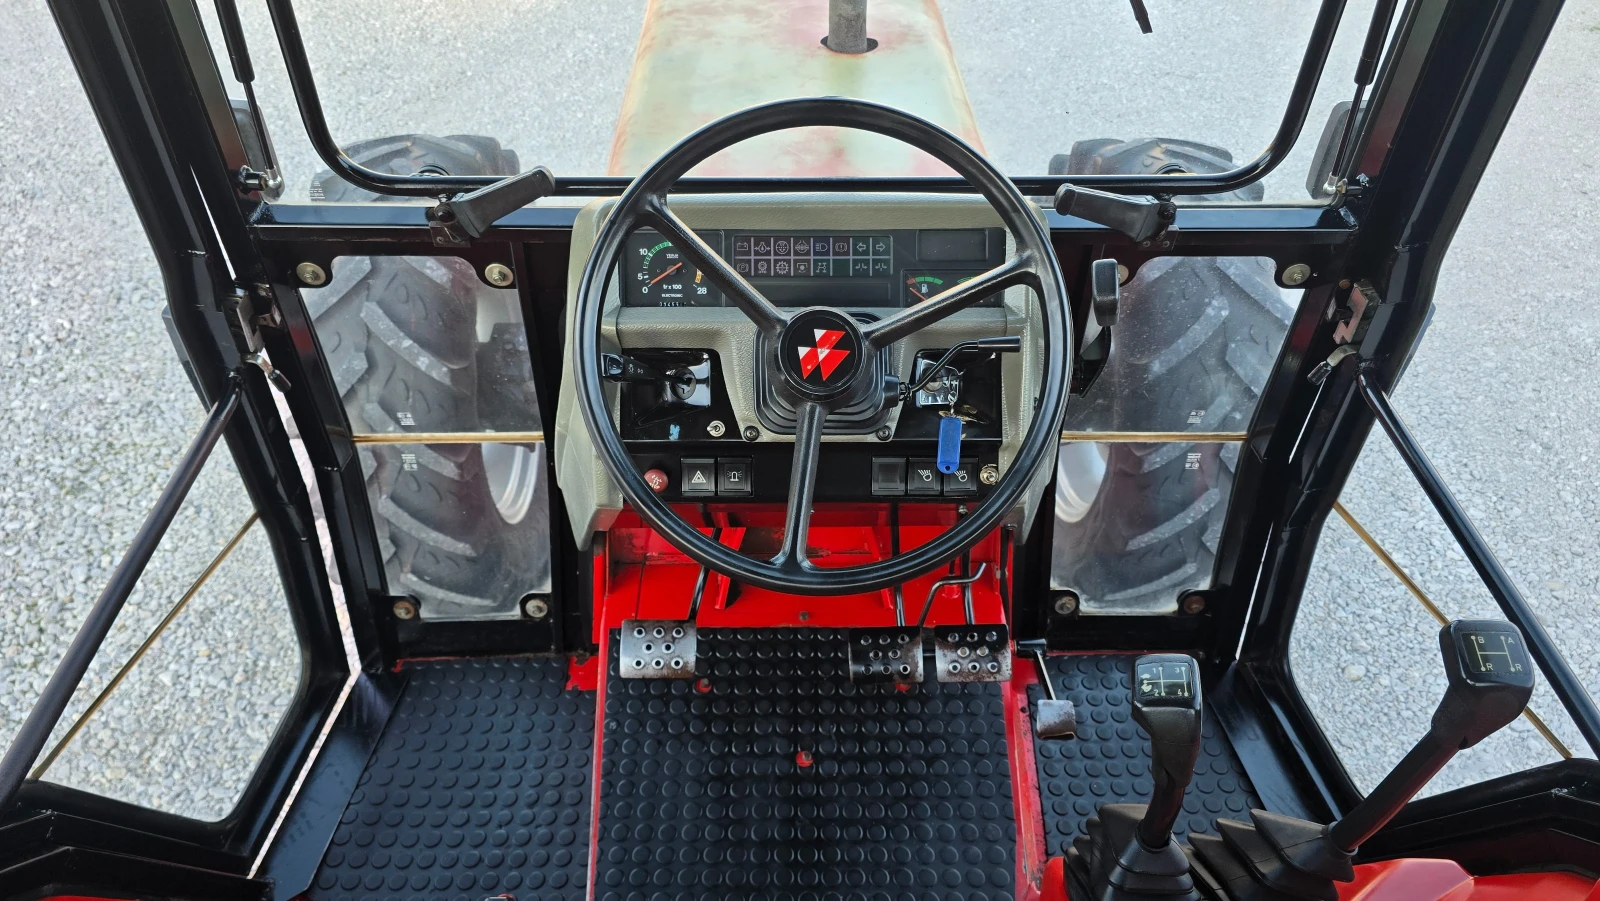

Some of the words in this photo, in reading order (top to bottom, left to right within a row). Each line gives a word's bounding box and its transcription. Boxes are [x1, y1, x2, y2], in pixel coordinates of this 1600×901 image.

[639, 248, 648, 256] 10
[642, 286, 649, 294] 0
[697, 287, 707, 295] 28
[1477, 636, 1485, 644] B
[1507, 636, 1515, 644] A
[1485, 662, 1493, 671] R
[1514, 663, 1523, 672] R
[1153, 689, 1159, 697] 2
[1177, 688, 1183, 697] 4
